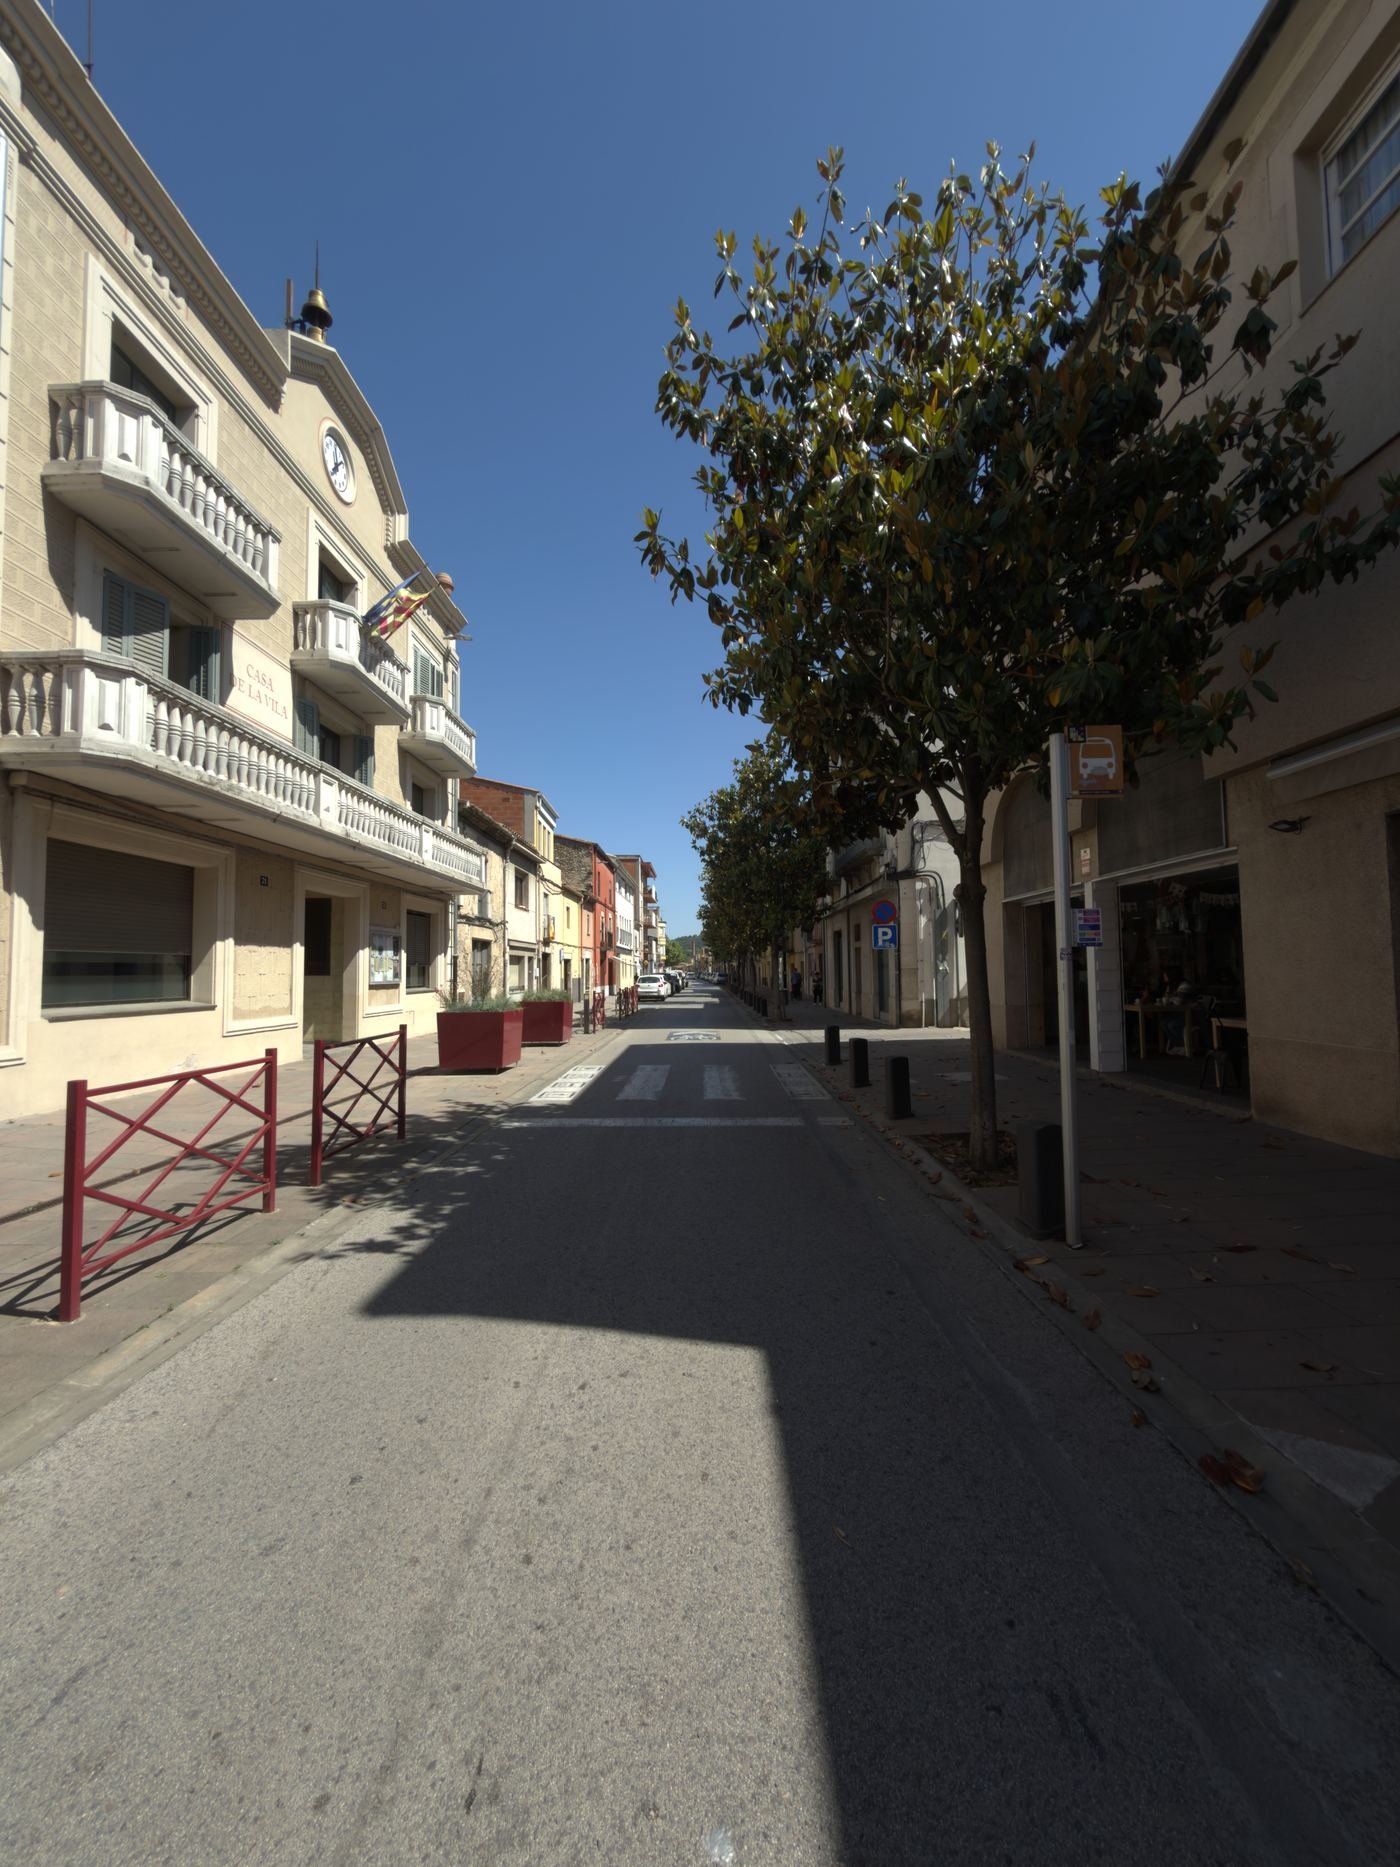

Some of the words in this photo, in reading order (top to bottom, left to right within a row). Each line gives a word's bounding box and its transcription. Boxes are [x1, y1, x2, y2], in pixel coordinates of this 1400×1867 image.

[246, 664, 274, 693] CASA
[230, 672, 245, 694] DE
[248, 684, 262, 704] LA
[264, 694, 288, 720] VILA
[877, 926, 893, 946] P
